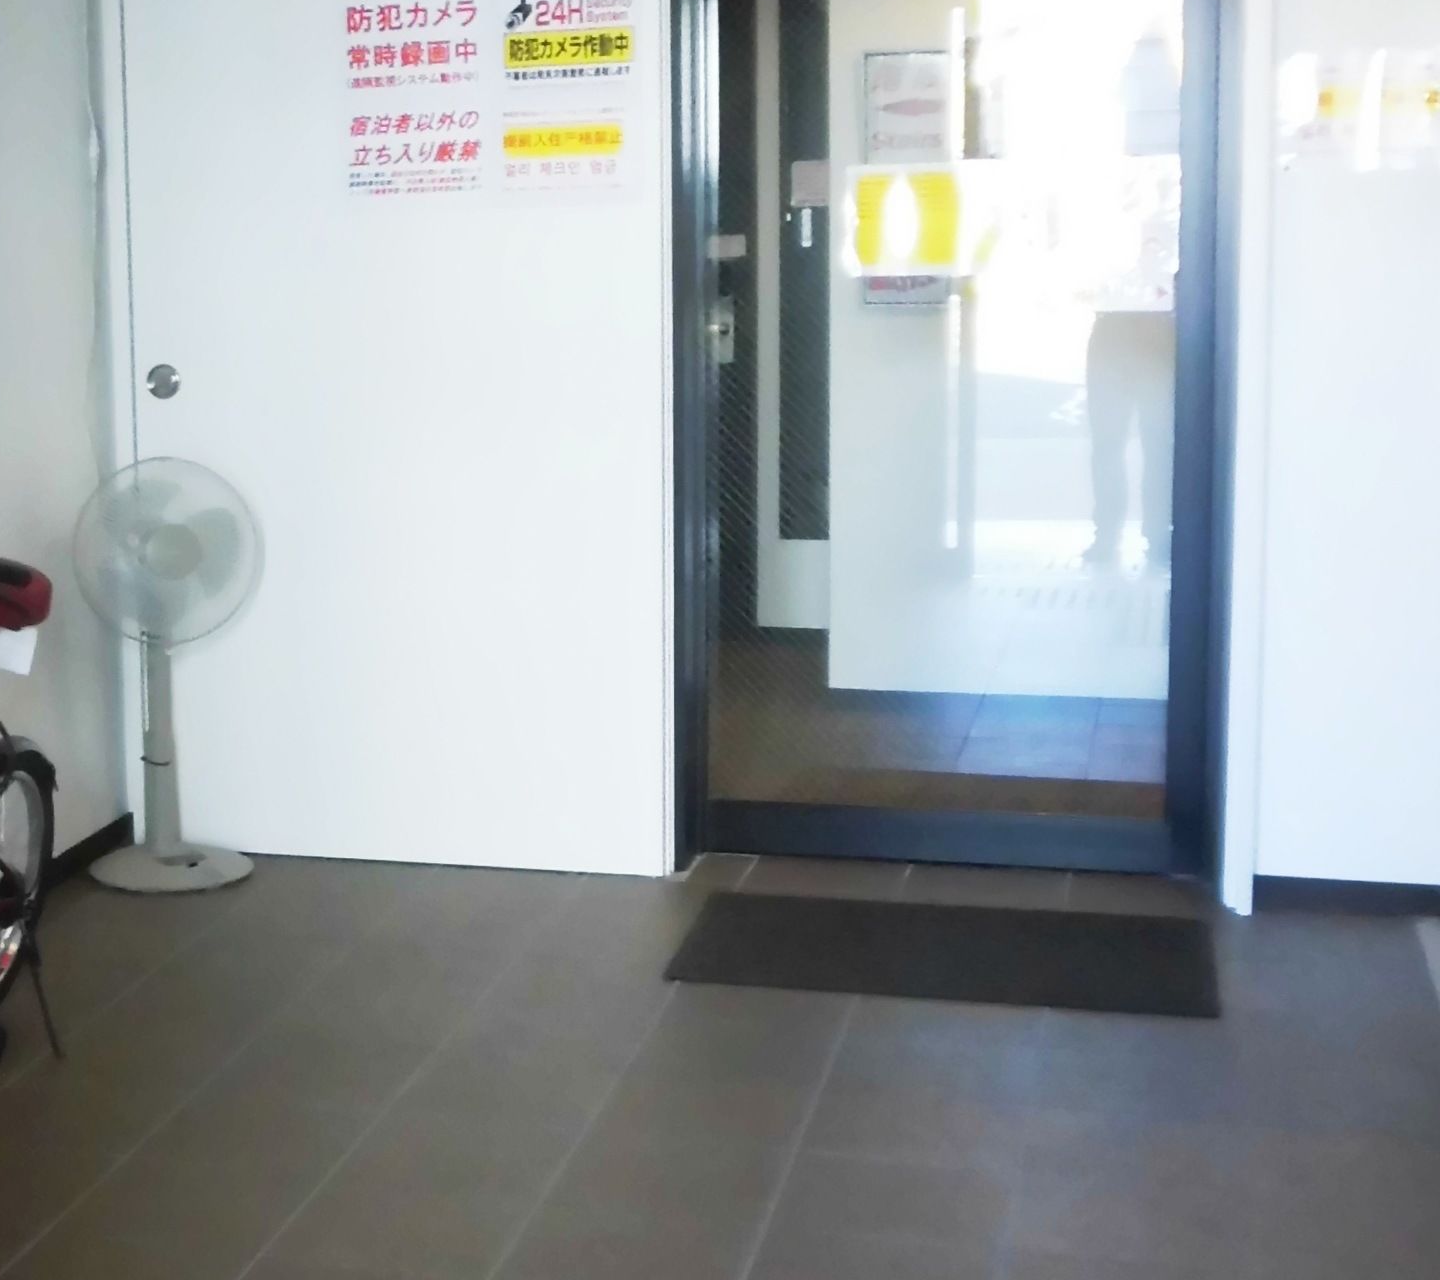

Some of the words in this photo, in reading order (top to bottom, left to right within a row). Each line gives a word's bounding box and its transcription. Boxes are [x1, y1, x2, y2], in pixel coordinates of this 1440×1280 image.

[347, 0, 479, 33] 防犯カメラ
[347, 38, 478, 69] 常時録画中
[509, 32, 629, 61] 防犯カメラ作動中
[349, 110, 480, 137] 宿泊者以外の
[348, 139, 482, 167] 立ち入り厳禁
